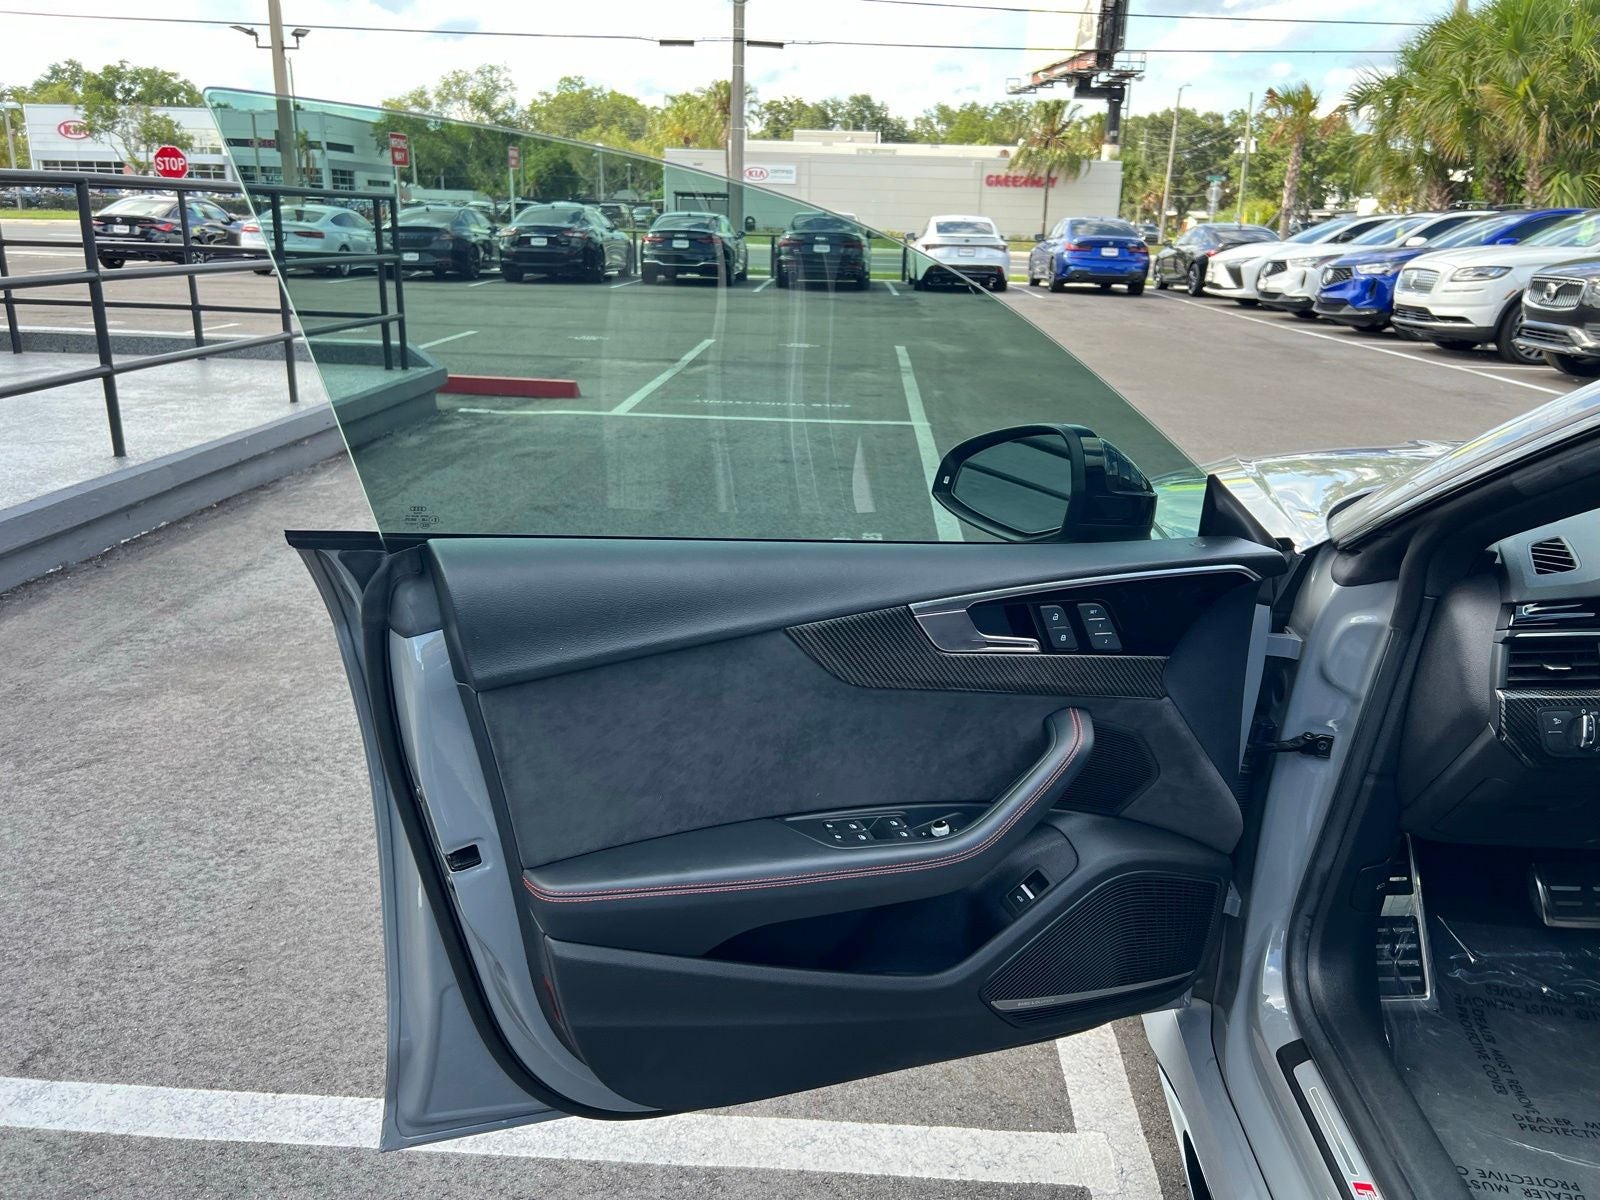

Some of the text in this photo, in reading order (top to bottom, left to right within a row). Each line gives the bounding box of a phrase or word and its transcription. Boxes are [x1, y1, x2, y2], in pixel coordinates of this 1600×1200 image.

[156, 156, 186, 171] STOP
[748, 170, 765, 178] KIA
[1456, 1004, 1509, 1096] PROTECTIVE COVER
[1489, 1047, 1515, 1075] MUST
[1506, 1077, 1541, 1115] REMOVE
[1512, 1112, 1575, 1127] DEALER
[1467, 1180, 1510, 1194] MUS
[1475, 1168, 1581, 1192] PROTECTIVE
